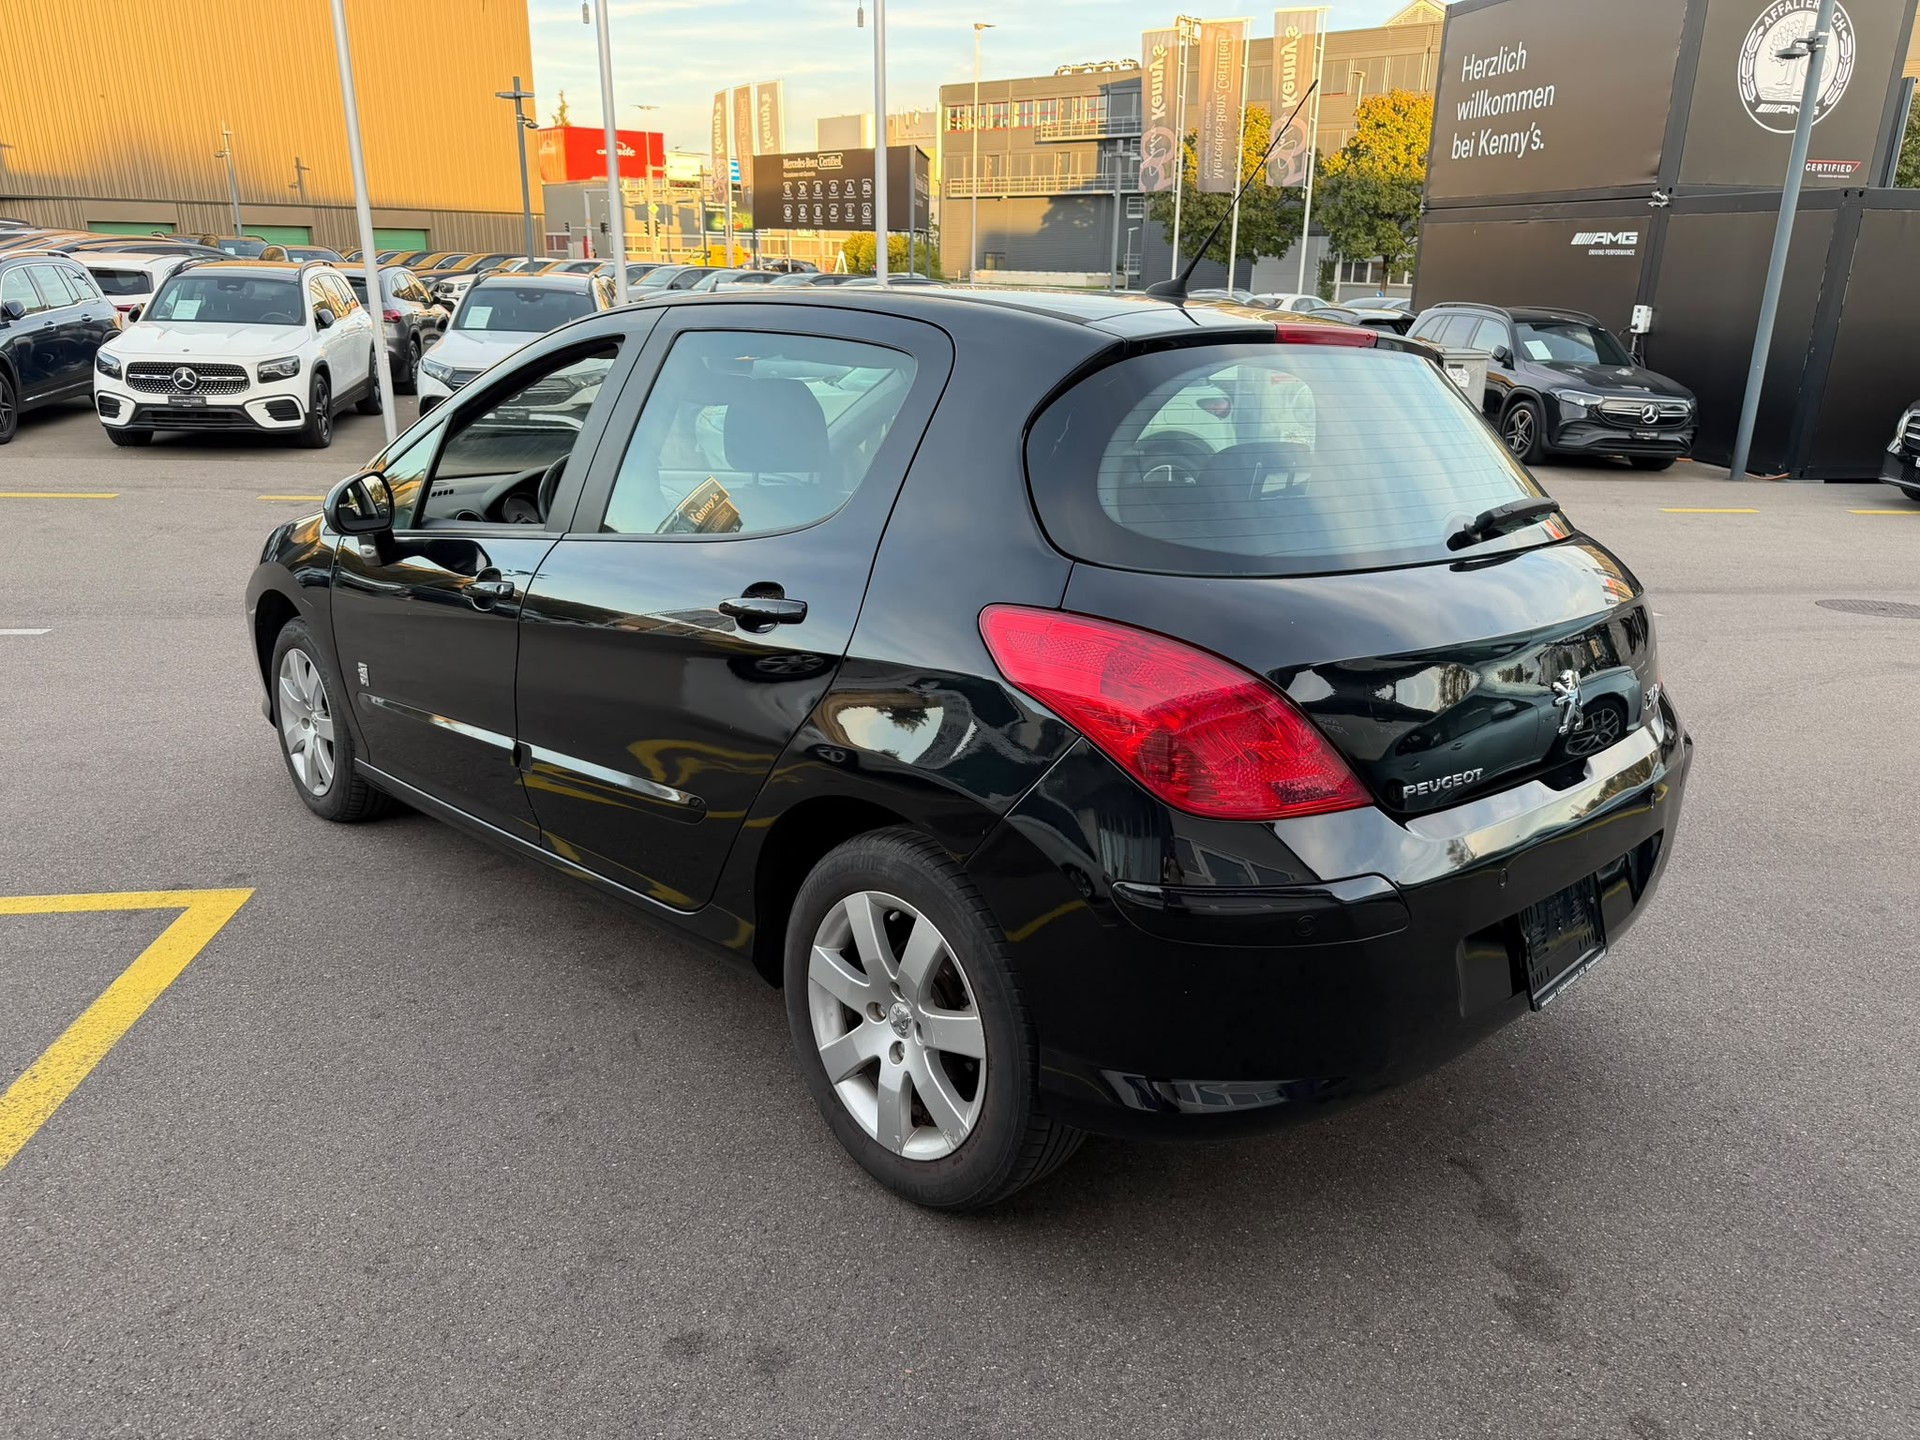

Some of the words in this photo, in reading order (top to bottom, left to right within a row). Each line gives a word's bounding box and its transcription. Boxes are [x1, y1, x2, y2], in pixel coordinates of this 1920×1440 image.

[1763, 0, 1847, 31] AFFALTERCH
[1461, 41, 1527, 82] Herzlich
[1457, 84, 1555, 121] willkommen
[1451, 131, 1476, 160] bei
[1478, 121, 1545, 159] Kenny's.
[1805, 163, 1852, 173] CERTIFIED
[1588, 248, 1605, 256] DRIVING
[1605, 248, 1636, 256] PERFORMANCE
[1402, 767, 1484, 800] PEUGEOT
